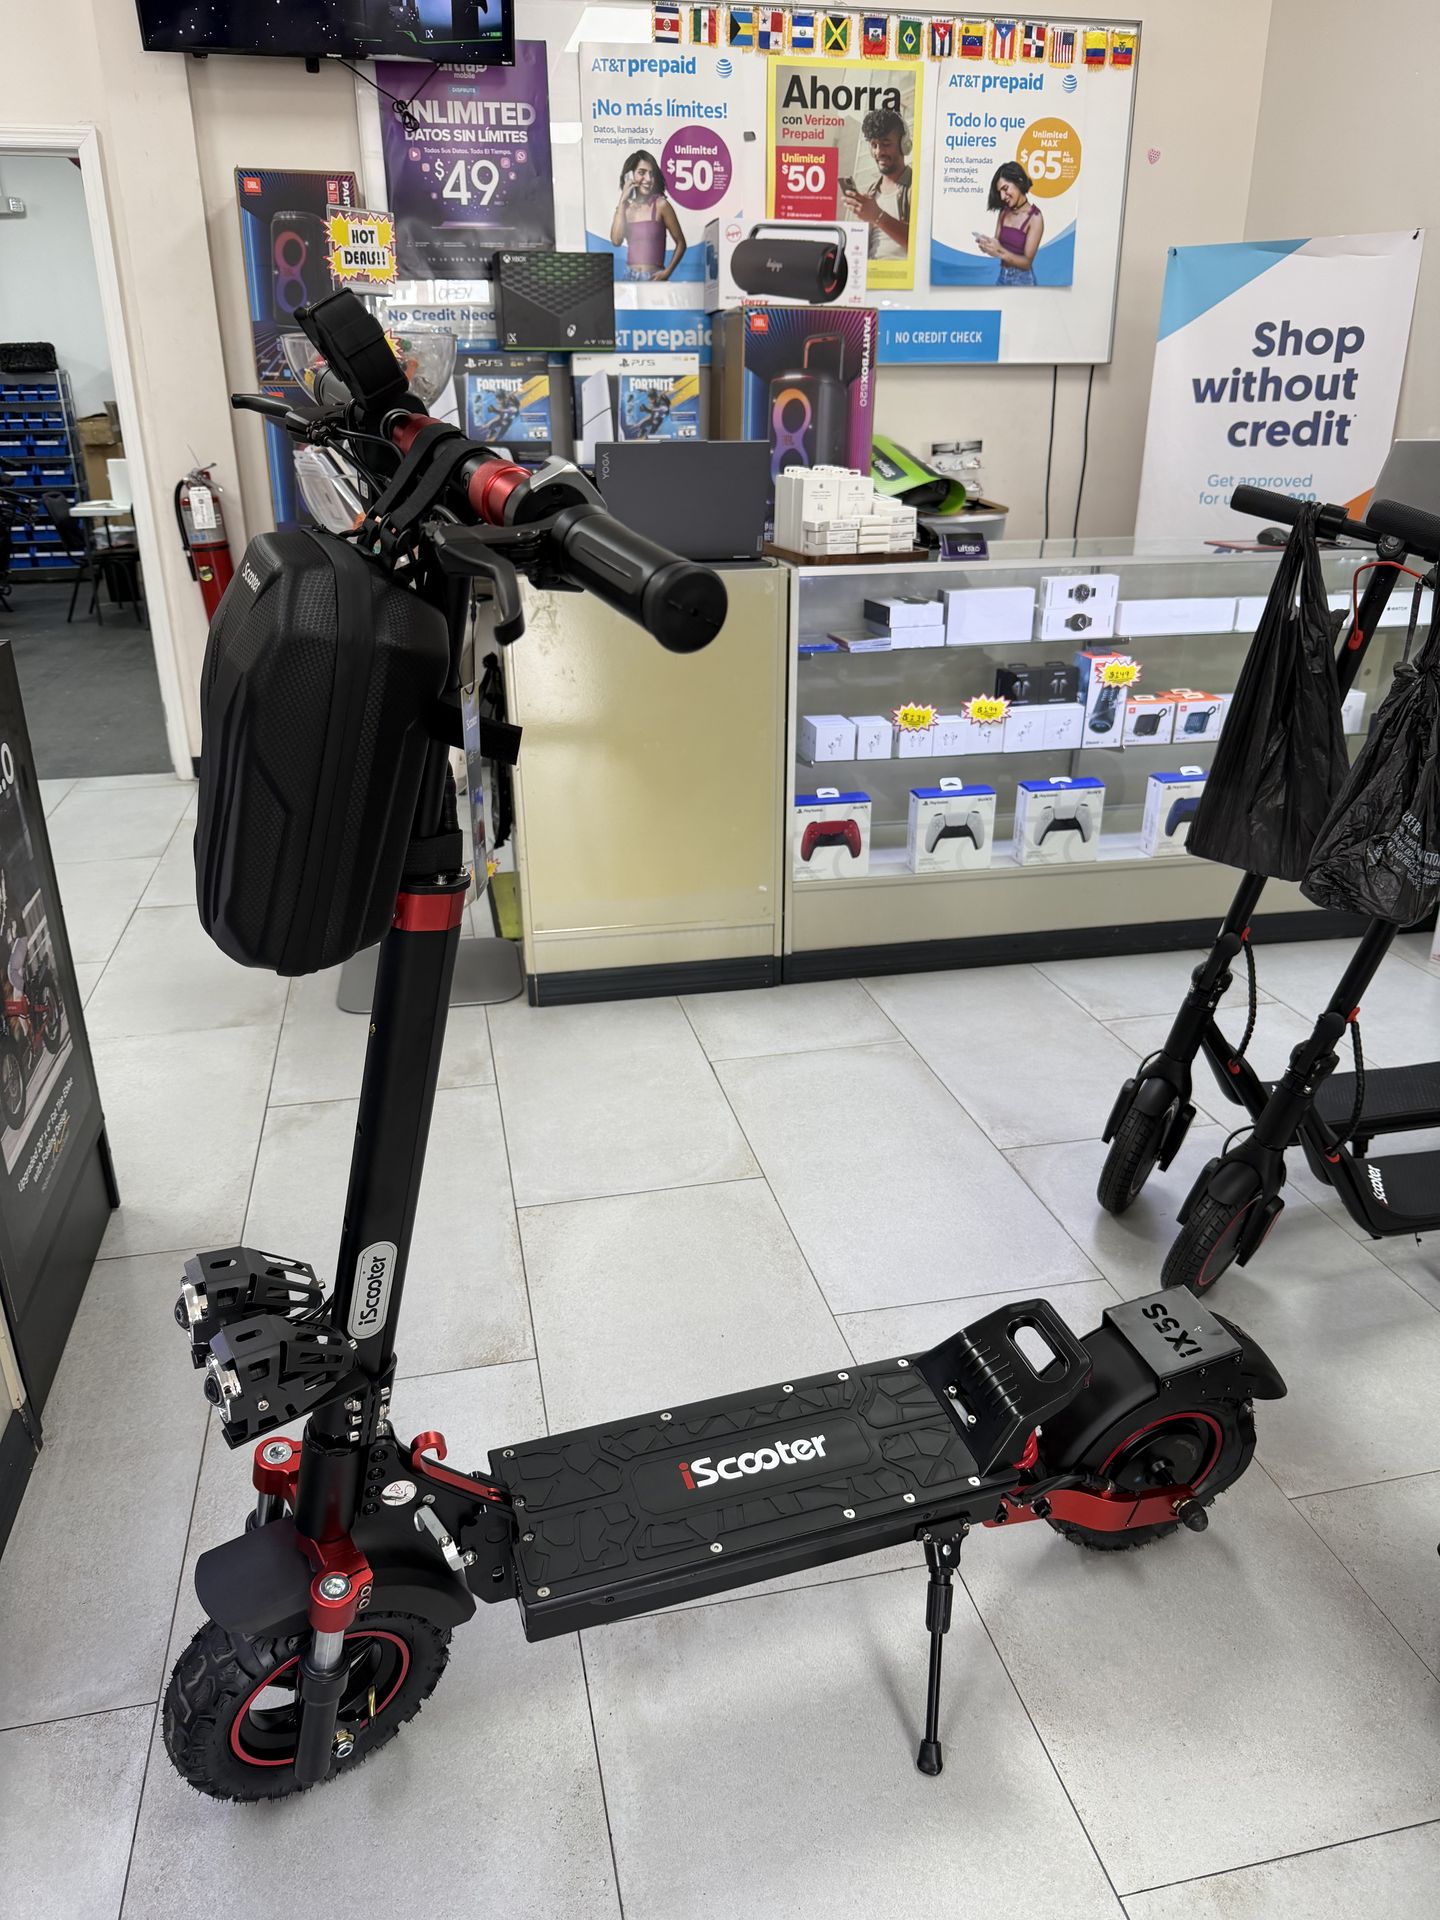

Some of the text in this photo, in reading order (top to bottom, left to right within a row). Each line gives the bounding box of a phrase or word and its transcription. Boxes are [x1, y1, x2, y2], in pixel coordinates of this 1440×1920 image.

[592, 55, 696, 77] AT&T prepaid
[454, 71, 476, 80] mobile
[949, 73, 1044, 93] AT&T prepaid
[782, 74, 901, 111] Ahorra
[592, 98, 728, 119] ¡No más límites!
[782, 114, 845, 127] con Verizon
[947, 113, 1025, 132] Todo lo que
[454, 129, 475, 142] SIN
[478, 126, 528, 143] LÍMITES
[593, 126, 654, 135] Datos, llamadas y
[782, 128, 825, 141] Prepaid
[1032, 130, 1068, 139] Unlimited
[594, 136, 662, 145] mensajes ilimitados
[945, 132, 997, 150] quieres
[674, 145, 718, 156] Unlimited
[781, 153, 826, 164] Unlimited
[944, 156, 993, 165] Datos, llamadas
[1020, 149, 1062, 180] $65
[435, 159, 500, 206] $49
[667, 158, 714, 192] $50
[781, 165, 826, 193] $50
[971, 185, 984, 193] más
[351, 229, 375, 244] HOT
[344, 252, 387, 266] DEALS!!
[388, 310, 407, 320] No
[412, 308, 456, 320] Credit
[895, 331, 982, 343] NO CREDIT CHECK
[1252, 320, 1365, 363] Shop
[476, 378, 523, 392] FORTNITE
[629, 377, 674, 392] FORTNITE
[1192, 367, 1358, 403] without
[1227, 410, 1352, 447] credit
[602, 452, 610, 480] YOGA
[1207, 474, 1313, 488] Get approved
[1199, 492, 1219, 505] for
[358, 1256, 387, 1325] iScooter
[679, 1433, 826, 1490] iScooter
